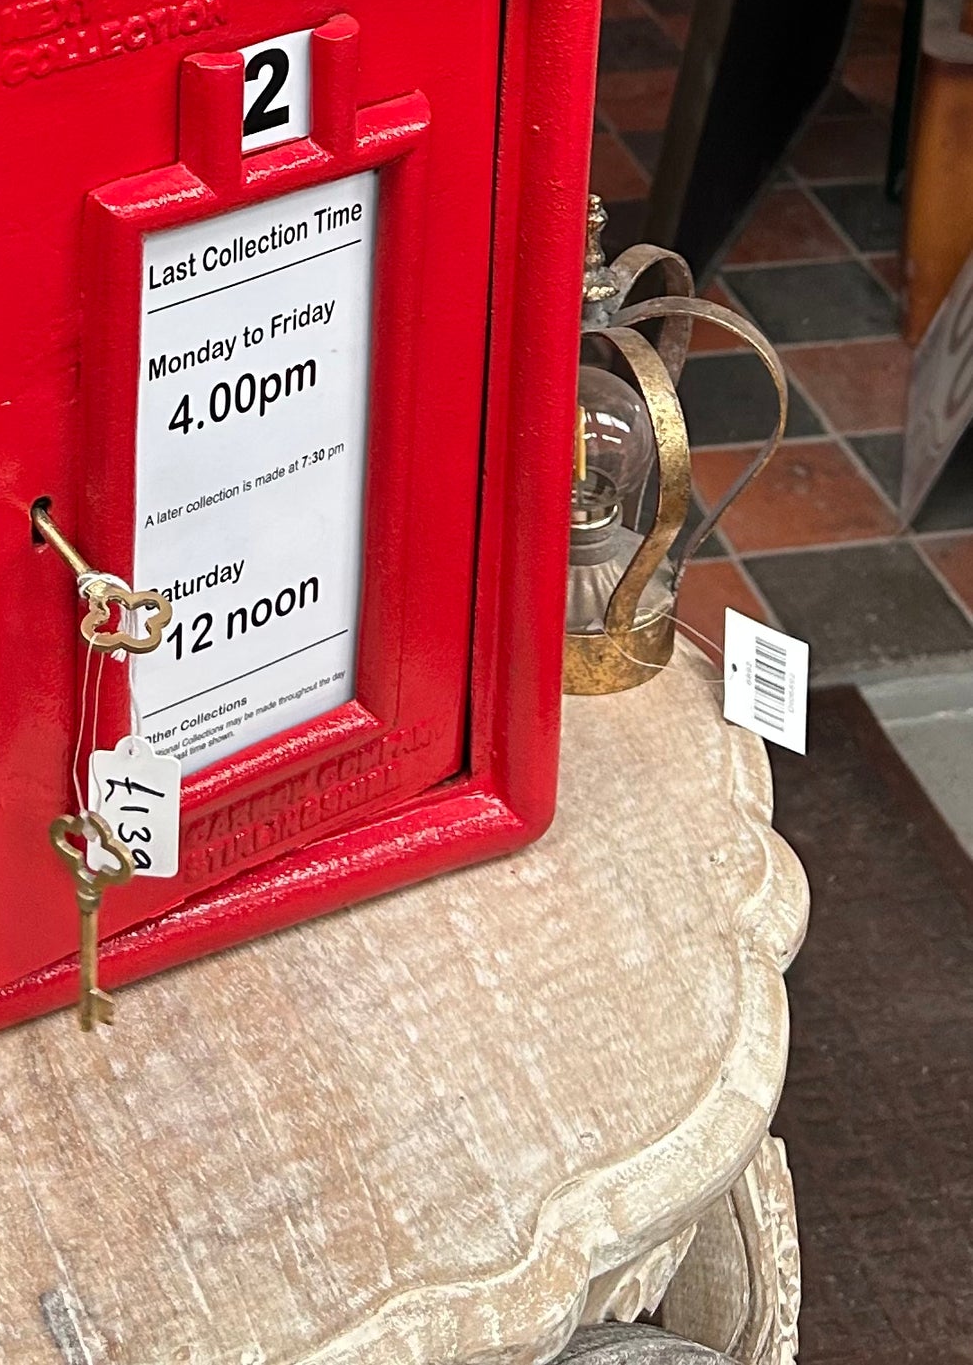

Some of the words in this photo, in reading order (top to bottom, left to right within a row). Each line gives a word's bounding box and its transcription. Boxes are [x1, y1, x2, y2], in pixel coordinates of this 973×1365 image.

[243, 48, 289, 137] 2
[149, 252, 197, 290] Last
[202, 221, 308, 272] Collection
[314, 203, 362, 235] Time
[148, 335, 237, 381] Monday
[243, 326, 264, 348] to
[270, 300, 335, 338] Friday
[168, 359, 317, 434] 4.00pm
[145, 514, 155, 529] A
[156, 504, 184, 525] later
[186, 485, 240, 514] collection
[242, 480, 252, 493] is
[255, 467, 286, 488] made
[288, 459, 299, 474] at
[301, 448, 325, 469] 7:30
[328, 442, 345, 460] pm
[167, 612, 213, 660] 12
[227, 576, 319, 640] noon
[180, 696, 247, 731] Collections
[182, 724, 224, 747] Collections
[256, 701, 277, 715] made
[332, 670, 346, 682] day
[105, 777, 165, 869] £139
